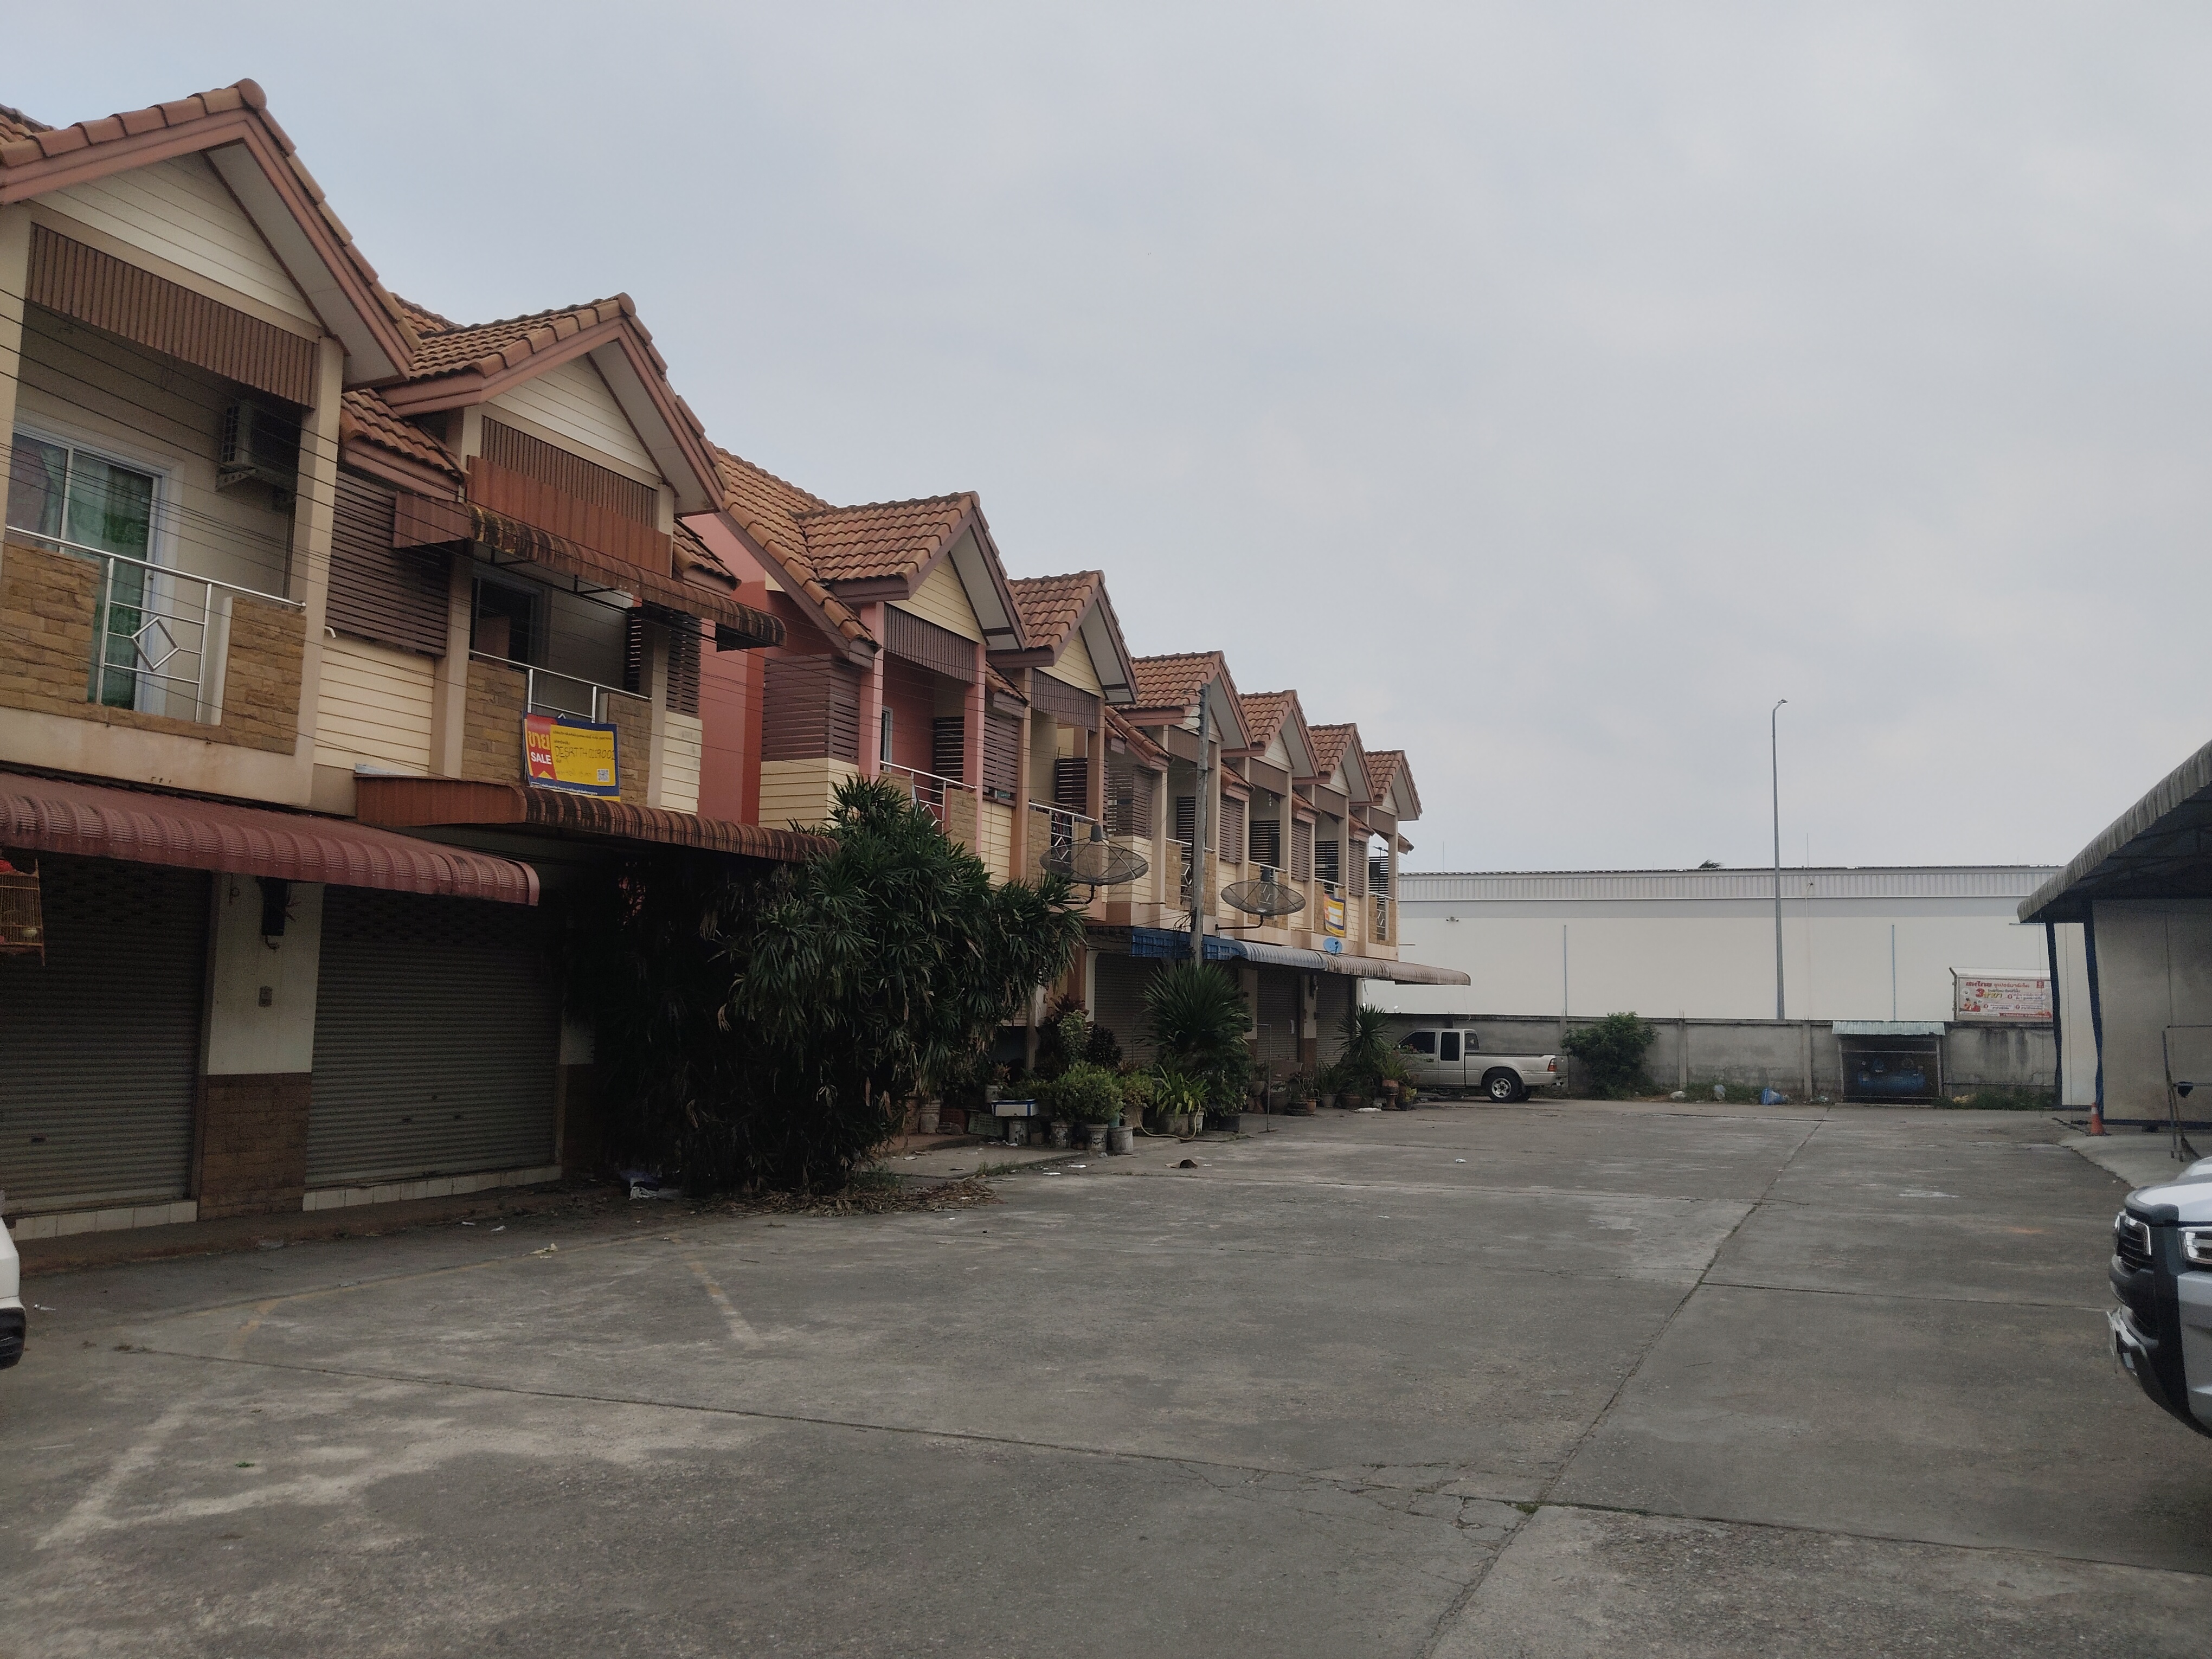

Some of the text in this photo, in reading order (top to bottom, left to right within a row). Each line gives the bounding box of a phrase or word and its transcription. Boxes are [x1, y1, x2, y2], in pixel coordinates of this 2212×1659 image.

[528, 731, 550, 750] ขาย
[530, 751, 552, 765] SALE
[1976, 988, 1985, 998] 3
